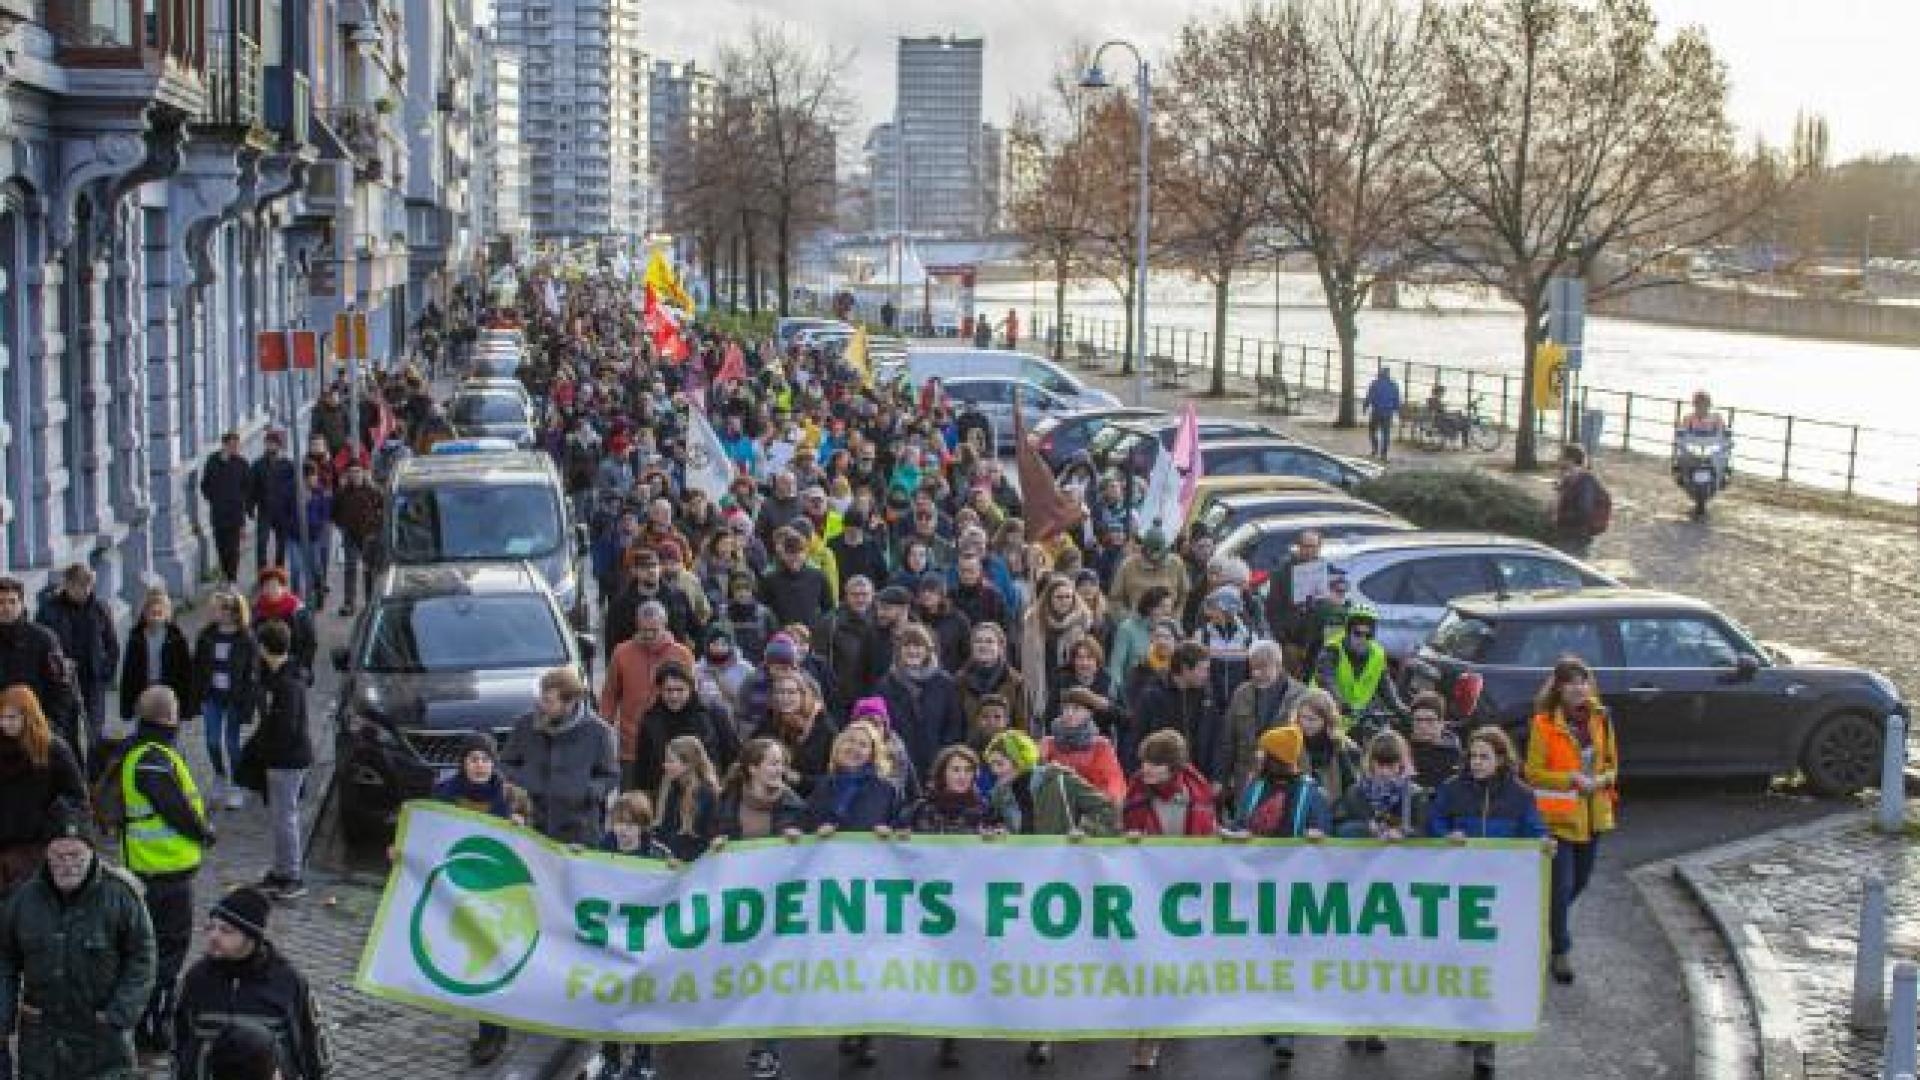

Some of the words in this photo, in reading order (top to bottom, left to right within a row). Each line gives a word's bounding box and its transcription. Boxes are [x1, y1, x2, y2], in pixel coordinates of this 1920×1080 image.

[574, 879, 957, 952] STUDENTS
[985, 881, 1137, 940] FOR
[1160, 881, 1498, 940] CLIMATE
[565, 968, 656, 1004] FOR
[668, 968, 697, 1002] A
[713, 959, 867, 998] SOCIAL
[879, 958, 976, 996] AND
[990, 960, 1295, 997] SUSTAINABLE
[1312, 960, 1493, 998] FUTURE
